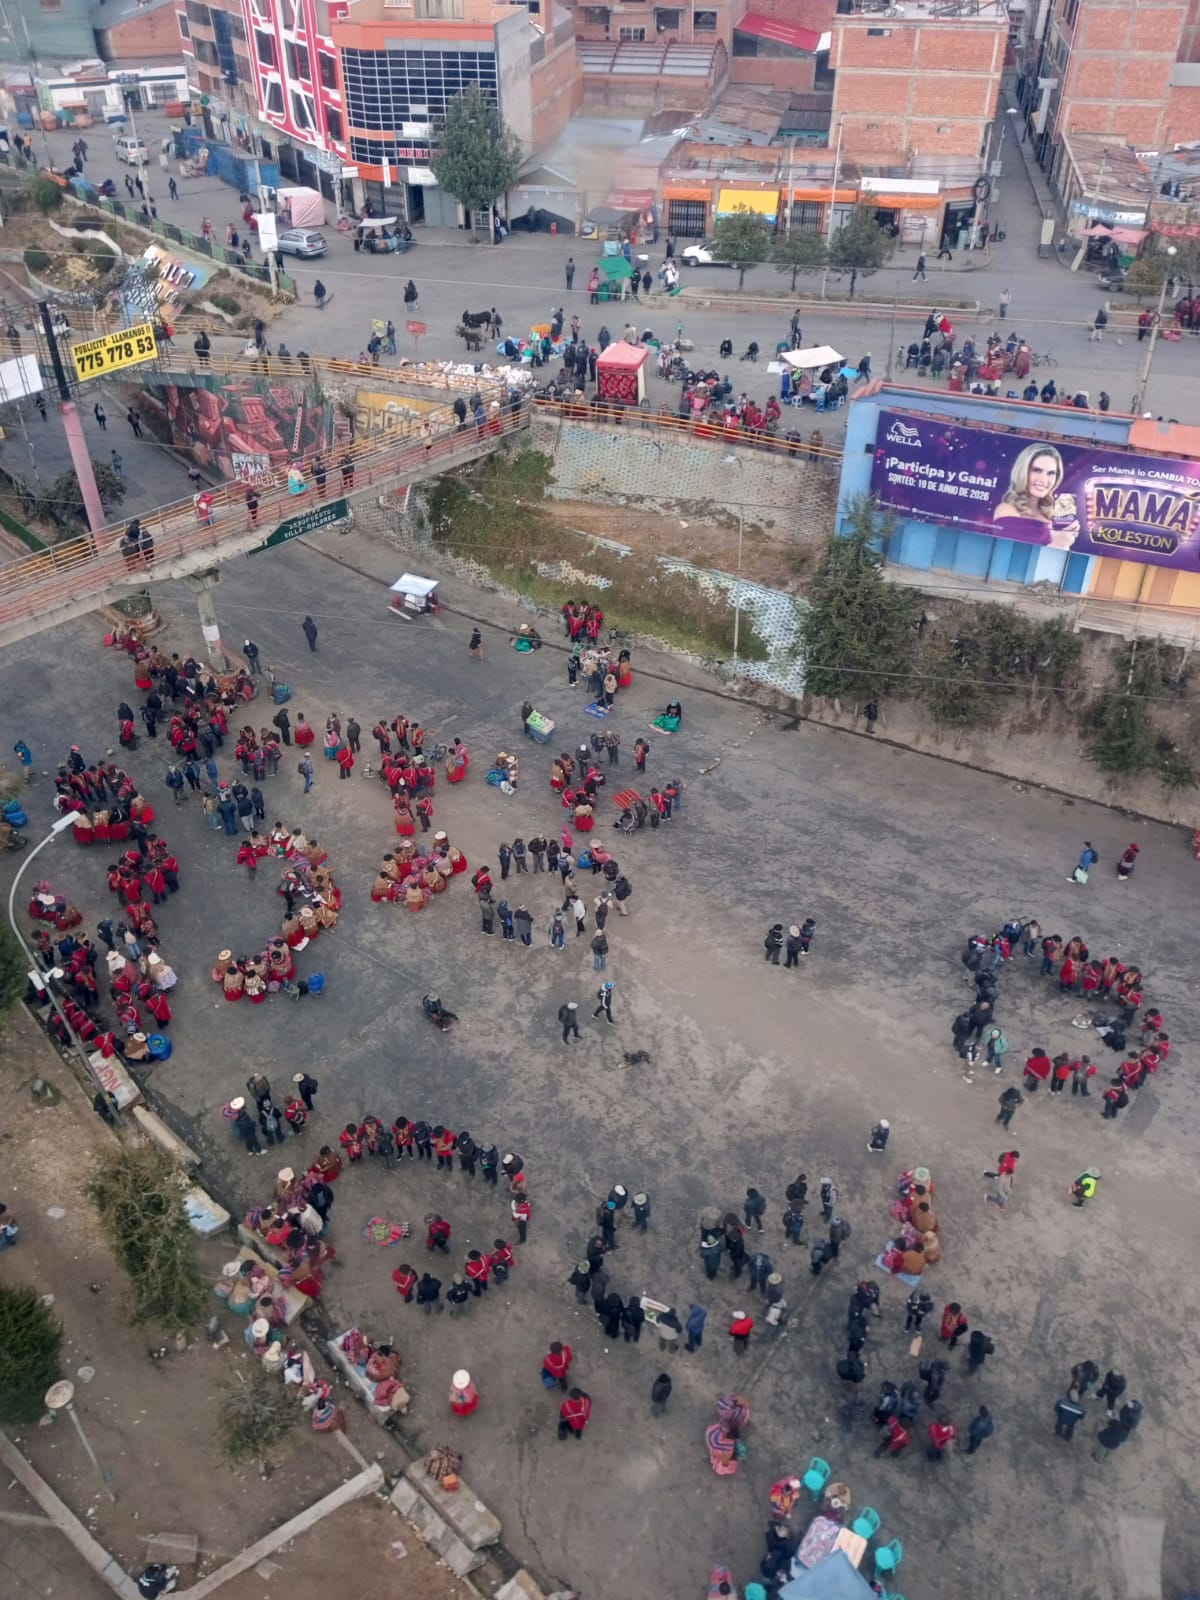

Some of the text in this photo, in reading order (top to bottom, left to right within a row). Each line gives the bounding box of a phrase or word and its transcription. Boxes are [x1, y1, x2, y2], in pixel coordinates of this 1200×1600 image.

[74, 339, 107, 356] PUBLICITE
[111, 326, 145, 344] LLAMANOS
[77, 350, 104, 373] 775
[106, 342, 133, 363] 778
[137, 335, 154, 354] 53
[886, 432, 922, 448] WELLA
[888, 472, 989, 501] SORTEO: 19 DE JUNIO DE 2026
[946, 471, 956, 482] y
[958, 471, 998, 488] Gana!
[1092, 465, 1200, 488] Ser Mamá lo CAMBIA TO
[284, 513, 337, 539] VILLA DOLORES
[289, 509, 332, 529] AEROPUERTO
[1097, 526, 1173, 550] KOLESTON
